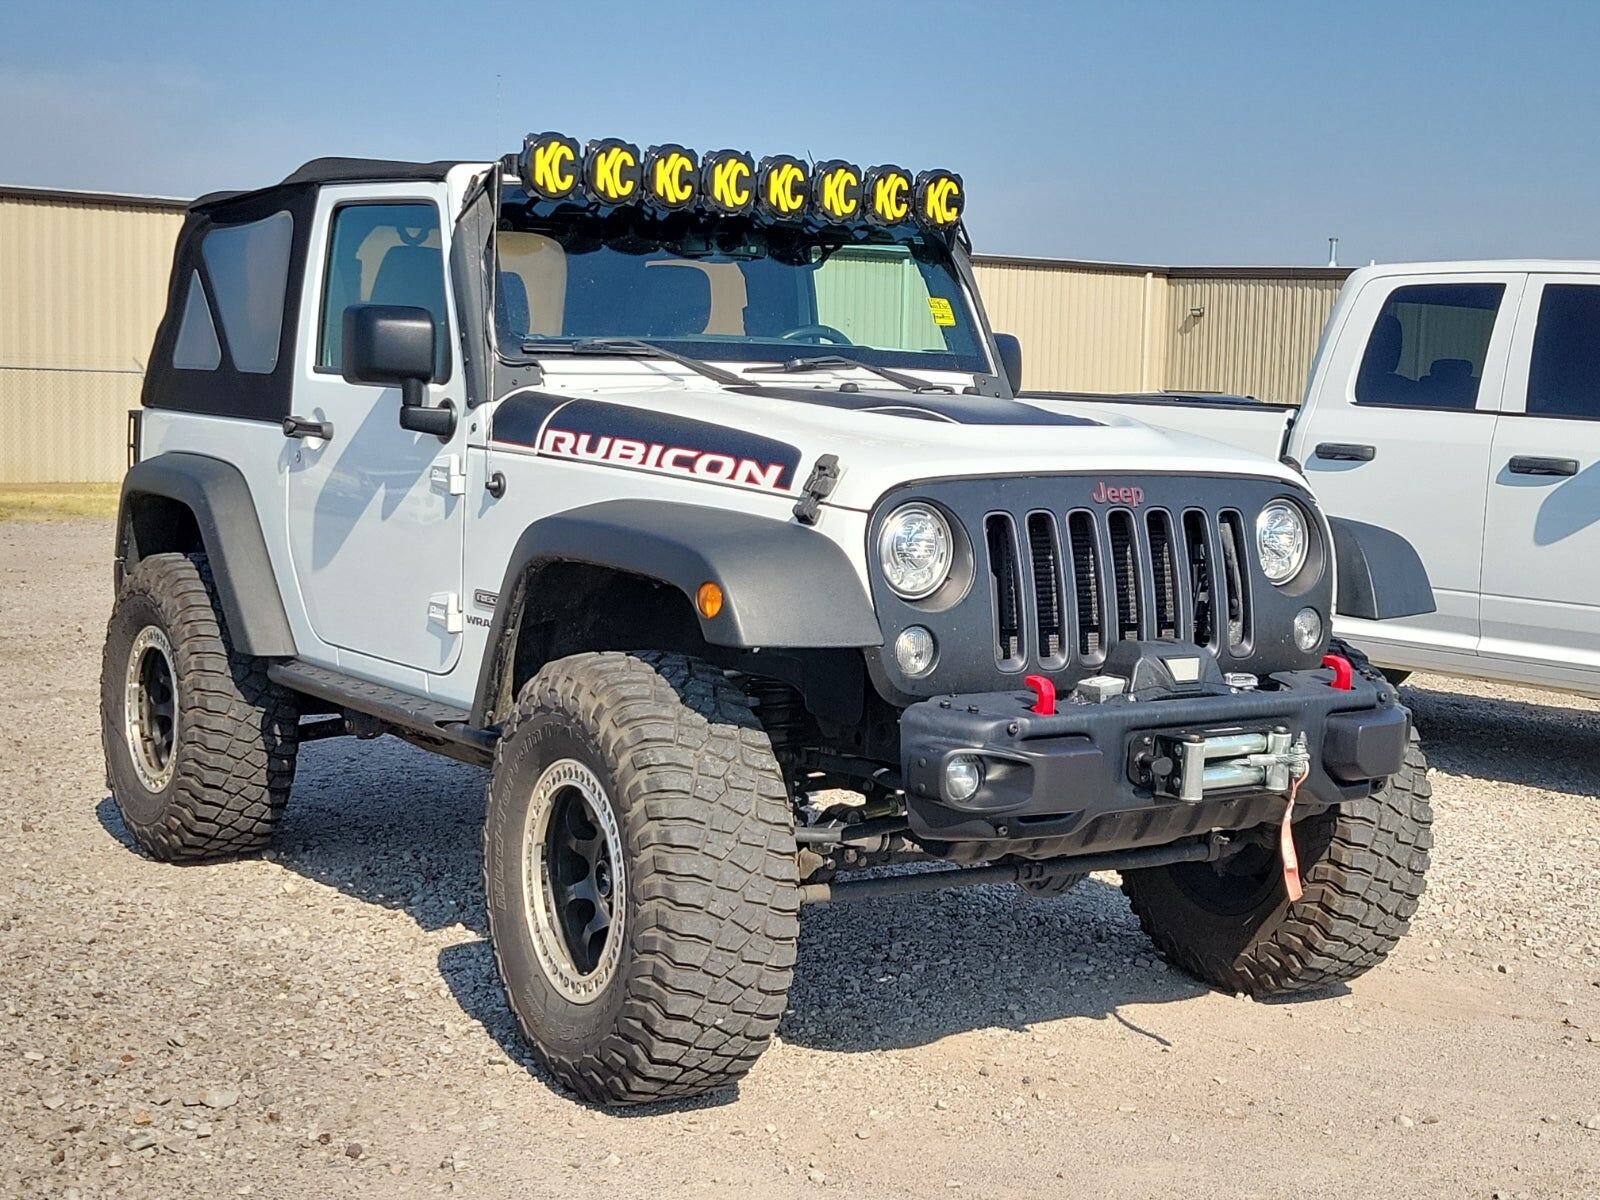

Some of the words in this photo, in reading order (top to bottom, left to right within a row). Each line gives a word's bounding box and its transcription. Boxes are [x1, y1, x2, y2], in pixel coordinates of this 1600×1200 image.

[534, 141, 574, 193] KC
[596, 147, 635, 199] KC
[655, 153, 693, 203] KC
[713, 159, 750, 206] KC
[769, 164, 804, 212] KC
[823, 168, 858, 216] KC
[874, 173, 909, 220] KC
[926, 178, 959, 224] KC
[542, 429, 789, 490] RUBICON
[1092, 480, 1144, 507] Jeep
